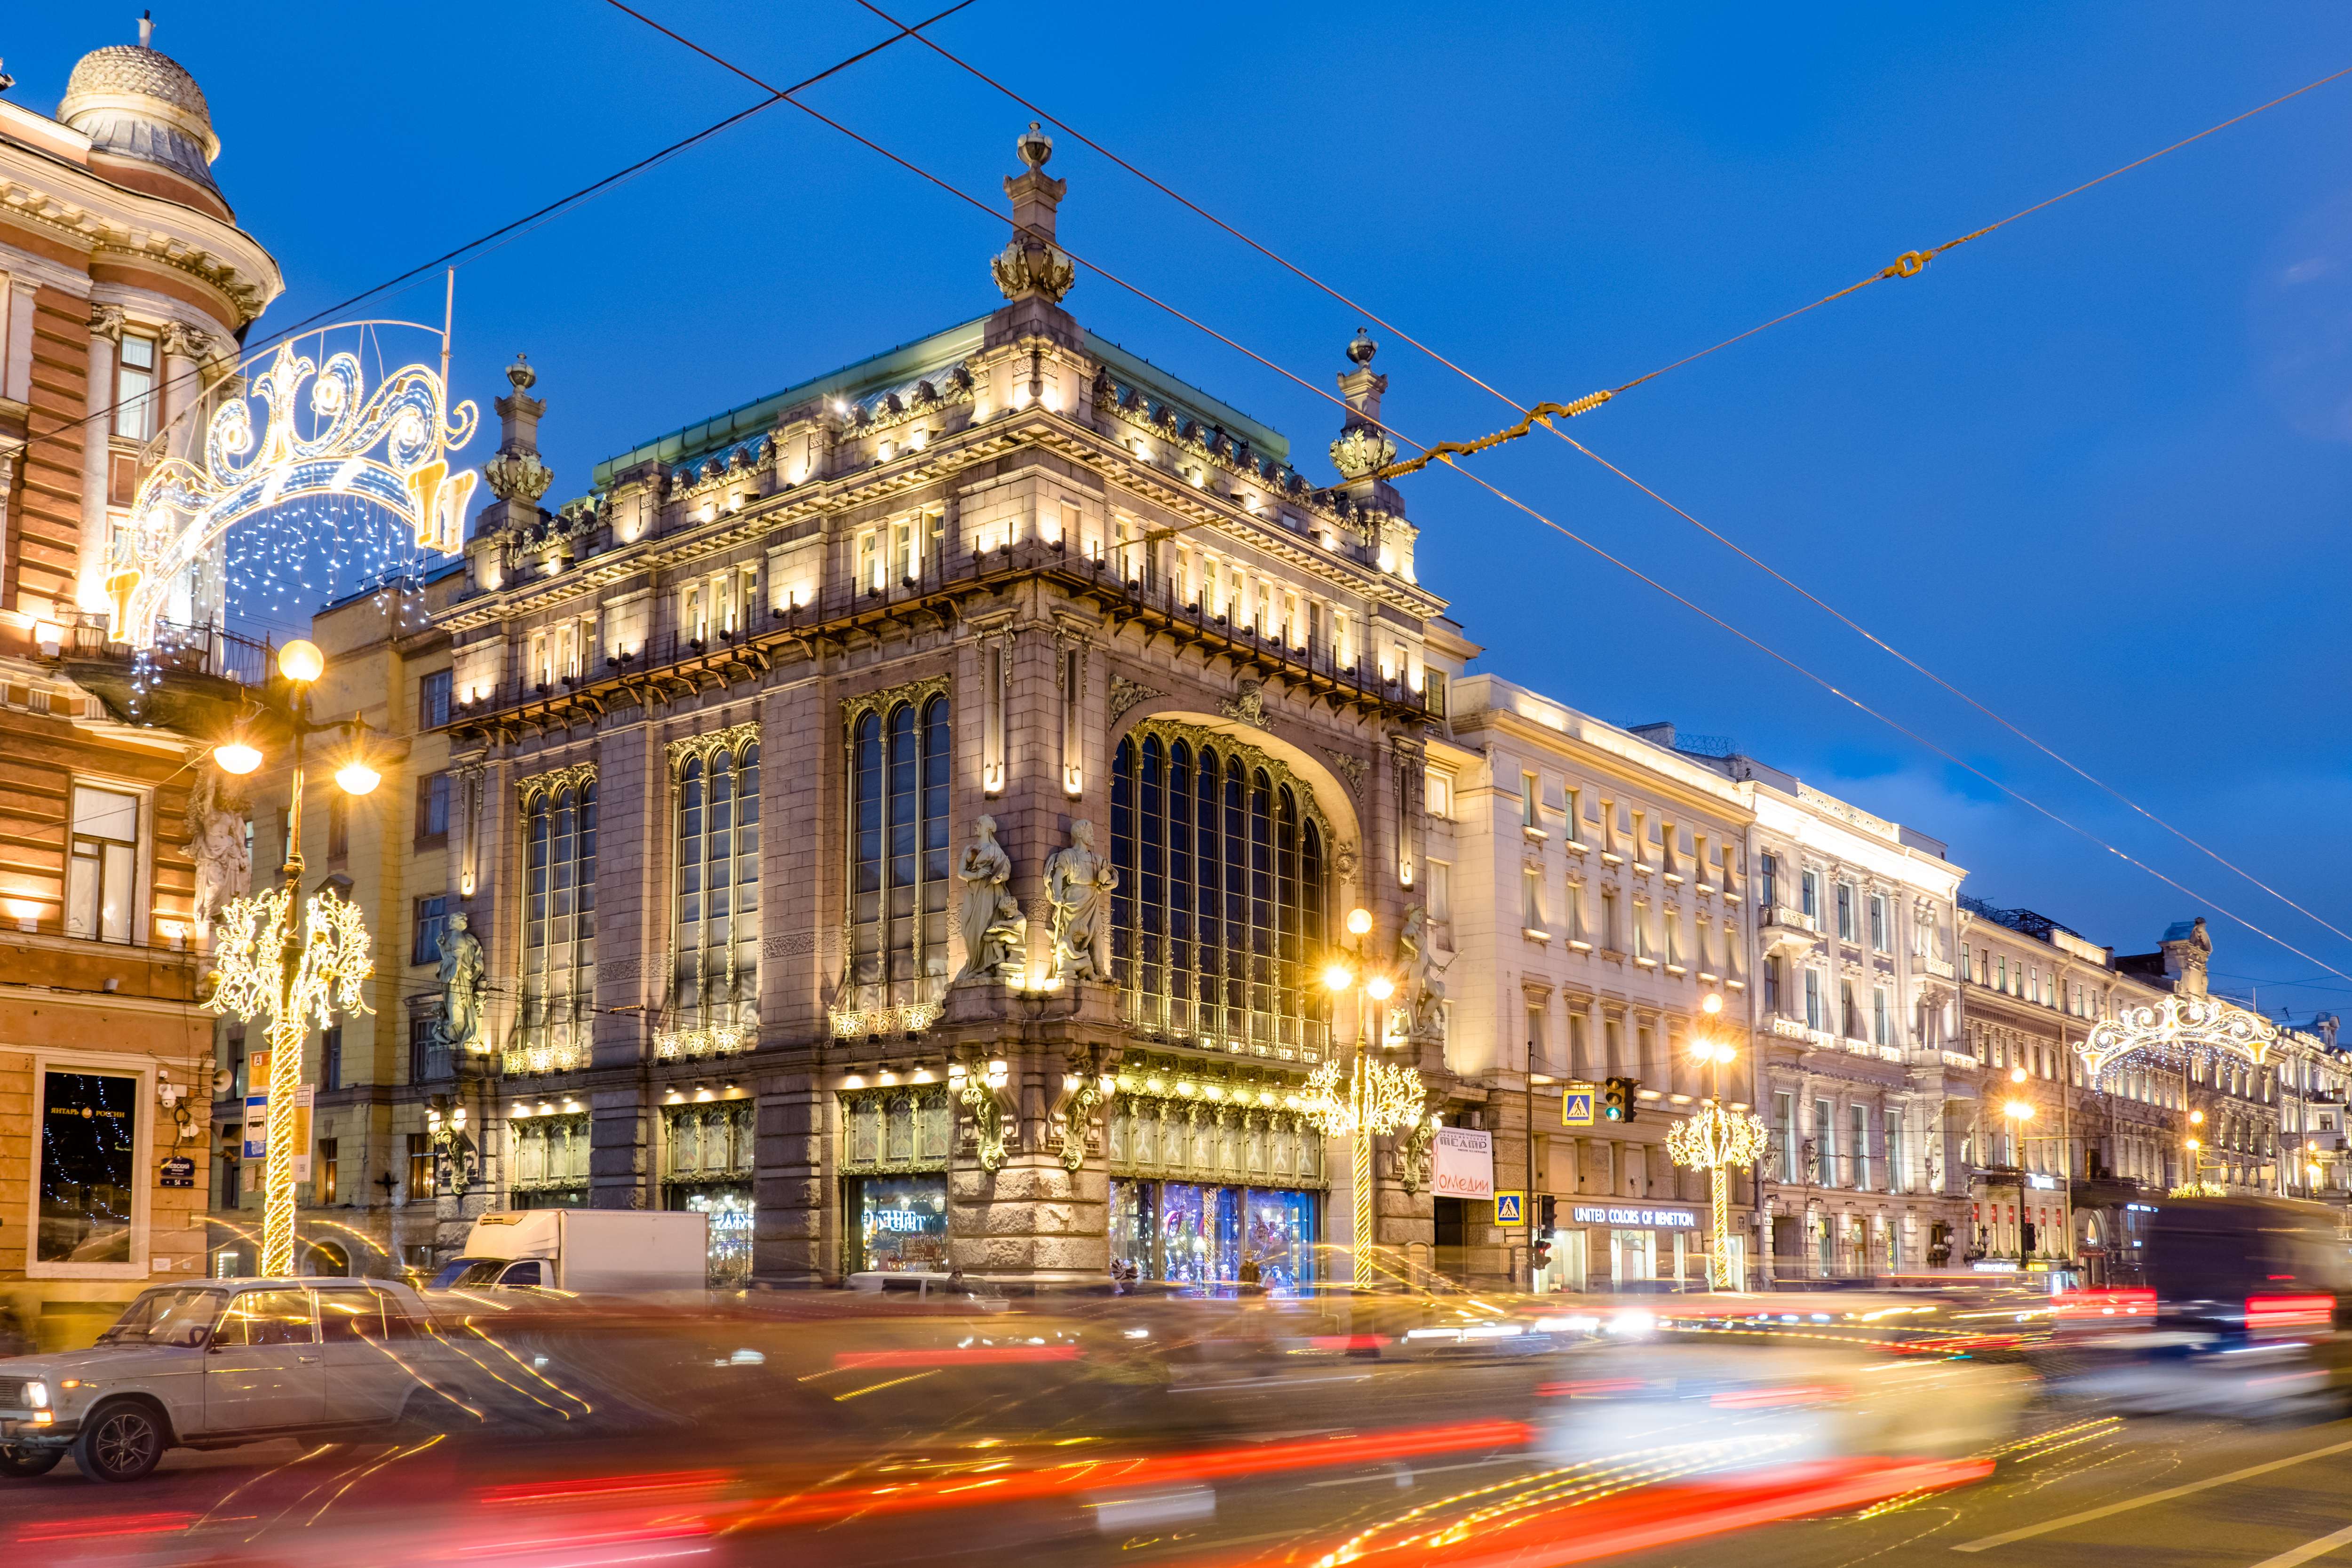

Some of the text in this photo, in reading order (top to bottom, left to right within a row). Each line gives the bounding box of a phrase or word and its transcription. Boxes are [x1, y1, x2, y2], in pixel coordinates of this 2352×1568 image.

[1574, 1208, 1605, 1223] UNITED
[1609, 1209, 1639, 1224] COLORS
[1642, 1211, 1653, 1225] OF
